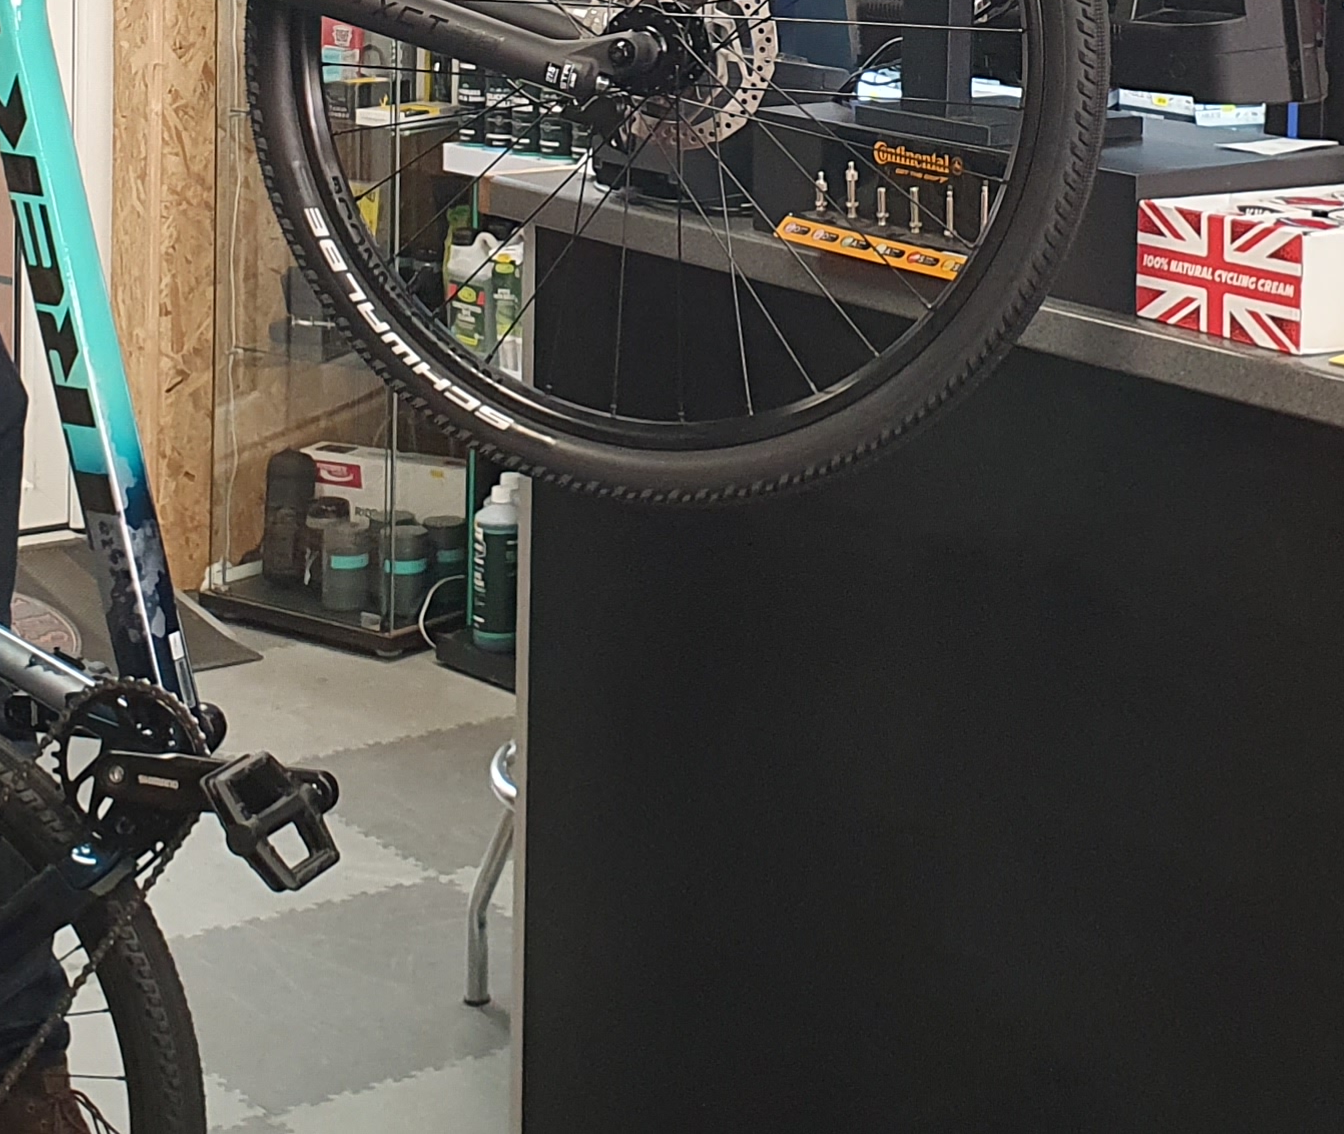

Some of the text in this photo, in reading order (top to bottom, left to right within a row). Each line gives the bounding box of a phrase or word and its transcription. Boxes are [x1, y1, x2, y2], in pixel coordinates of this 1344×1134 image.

[873, 141, 949, 174] Continental
[1143, 254, 1295, 298] 100% NATURAL CYCLING CREAM
[305, 208, 515, 432] SCHWALBE
